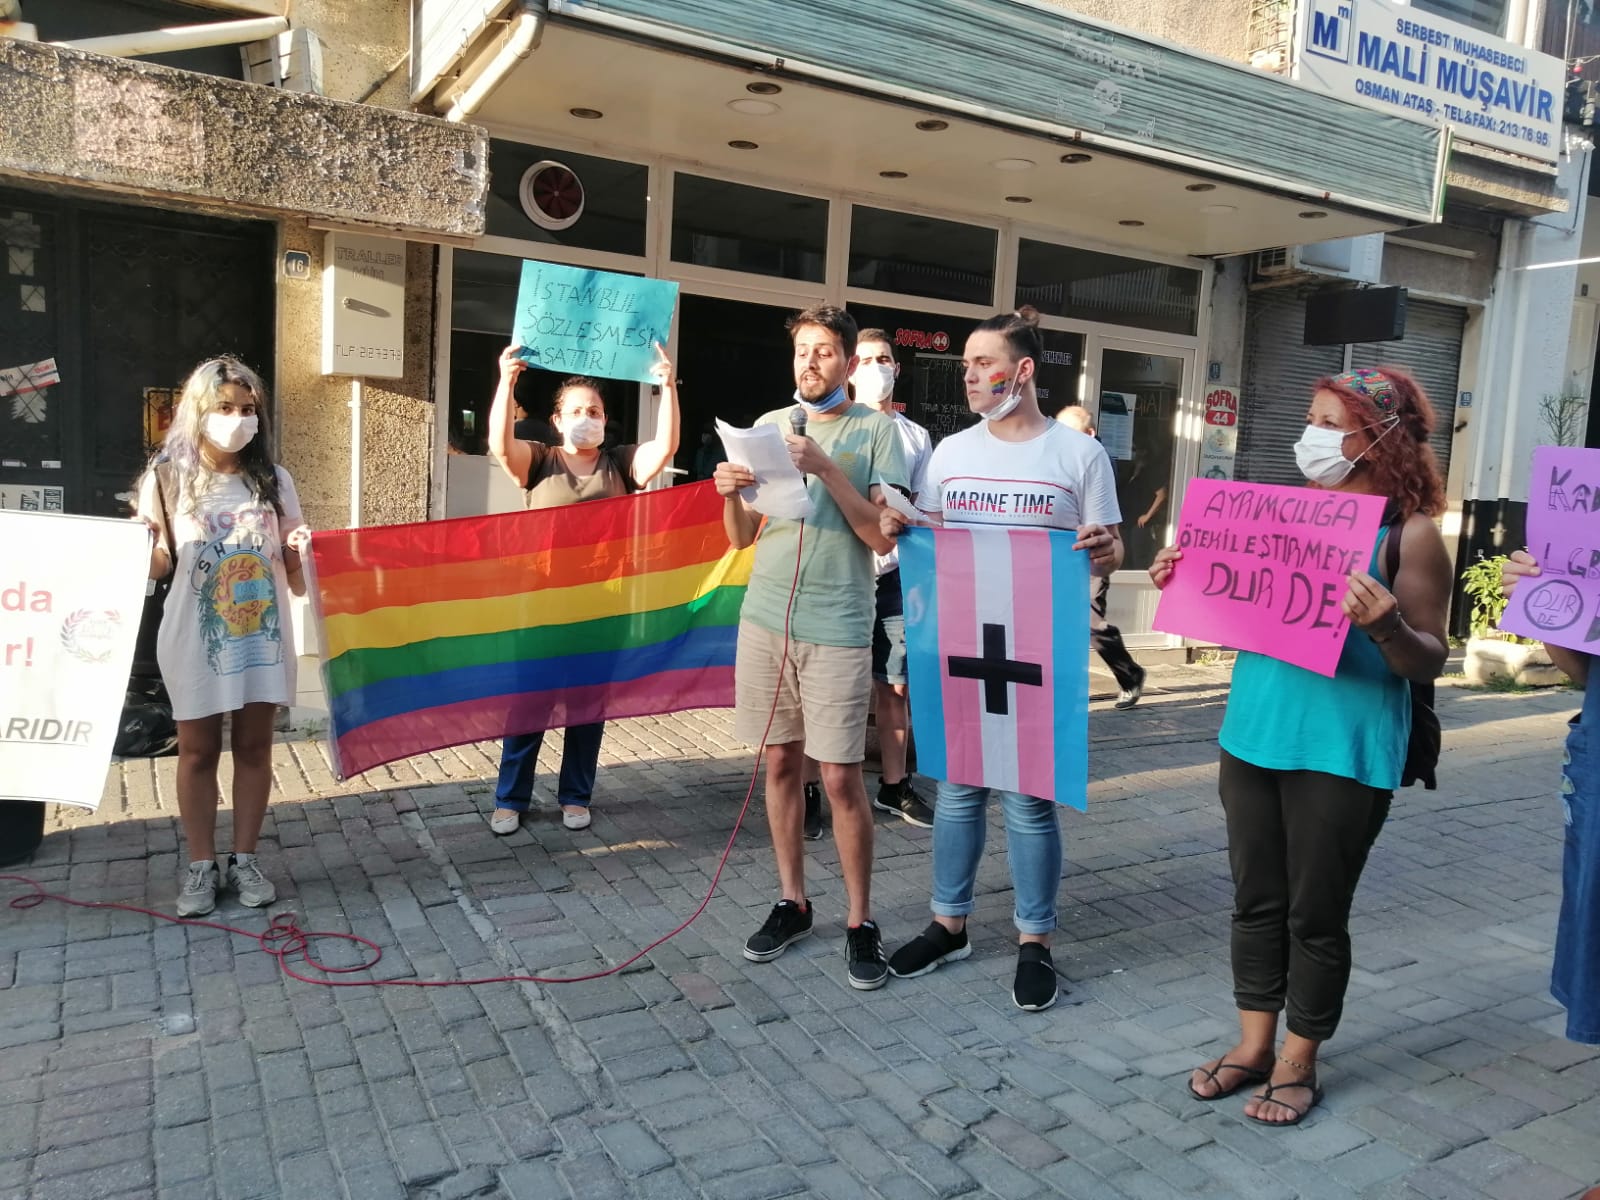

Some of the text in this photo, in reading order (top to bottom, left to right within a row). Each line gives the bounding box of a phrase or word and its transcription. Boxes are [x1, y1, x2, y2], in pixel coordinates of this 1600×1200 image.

[1396, 18, 1450, 48] SERBEST
[1357, 31, 1553, 122] MALİ MÜŞAVİR
[1355, 78, 1400, 105] OSMAN
[1443, 104, 1496, 131] TEL&FAX:
[1499, 120, 1518, 137] 213
[292, 259, 304, 273] 16
[533, 269, 640, 314] İSTANBUL
[895, 328, 949, 349] SOFRA 44
[1205, 389, 1237, 416] SOFRA
[1213, 413, 1229, 425] 44
[946, 491, 1056, 515] MARINE TIME
[1203, 489, 1359, 531] AYRIMCILIĞA
[1, 581, 53, 613] da
[1202, 562, 1348, 639] DUR DE!
[1532, 589, 1577, 614] DUR
[1536, 612, 1558, 625] DE
[5, 636, 34, 667] r!
[0, 717, 93, 743] RIDIR
